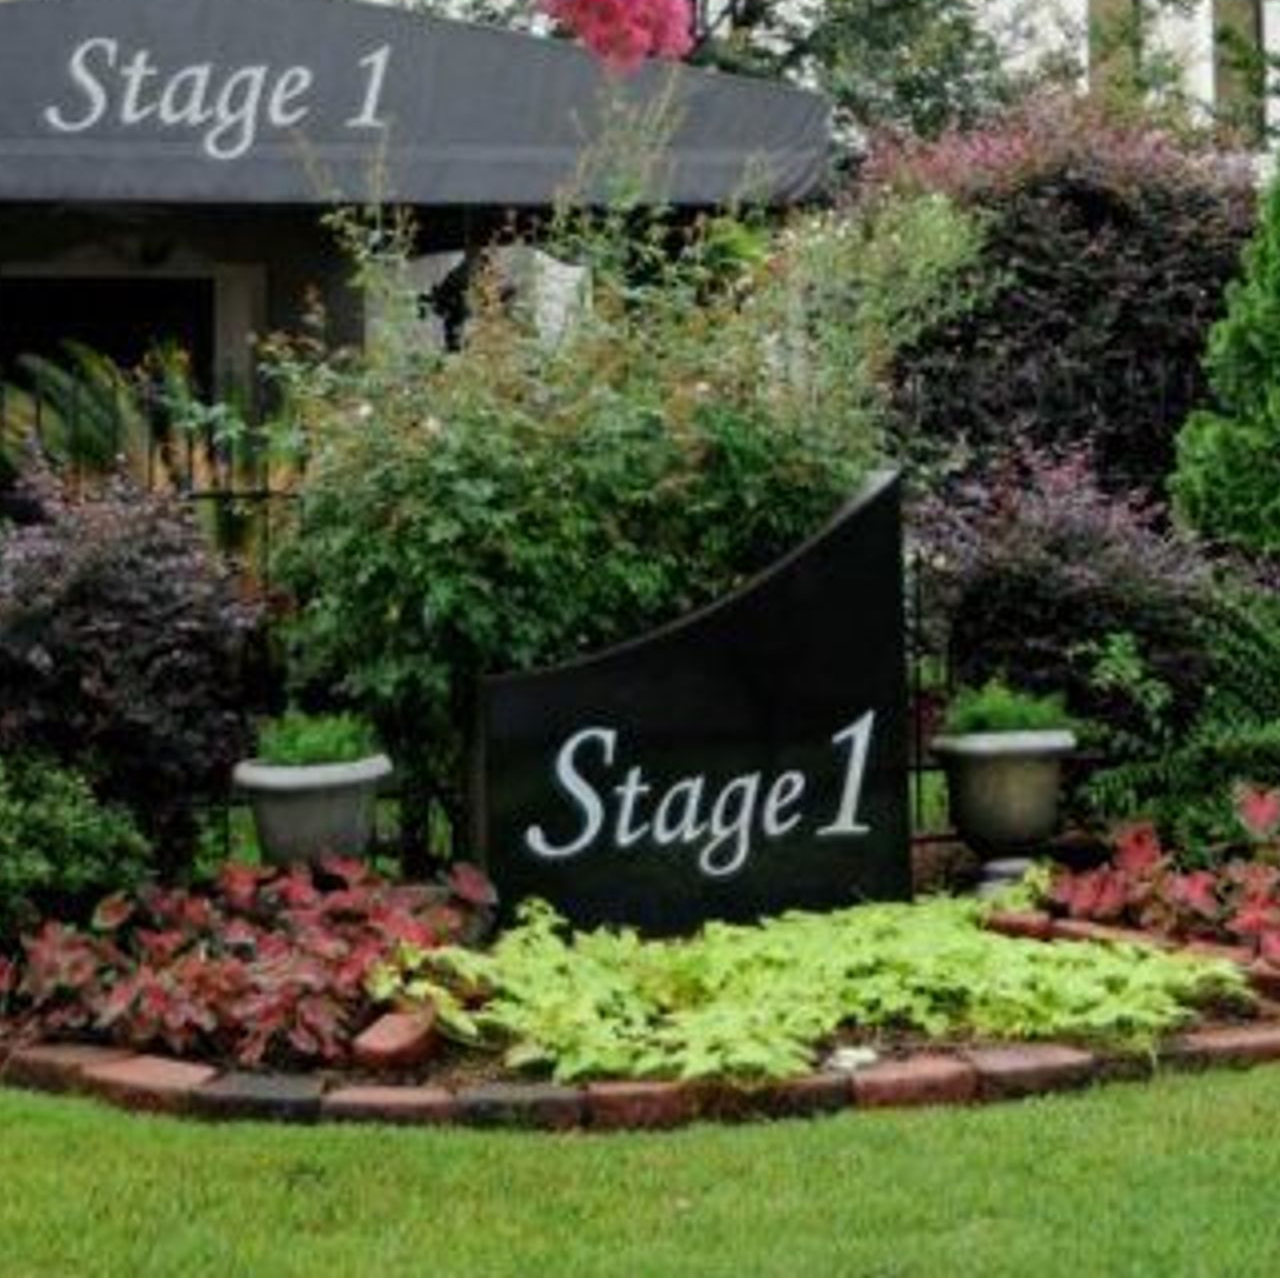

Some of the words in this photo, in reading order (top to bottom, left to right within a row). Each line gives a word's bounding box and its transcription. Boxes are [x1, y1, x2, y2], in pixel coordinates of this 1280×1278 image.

[44, 36, 313, 160] Stage
[344, 44, 393, 128] 1
[525, 727, 807, 876] Stage
[816, 710, 876, 836] 1
